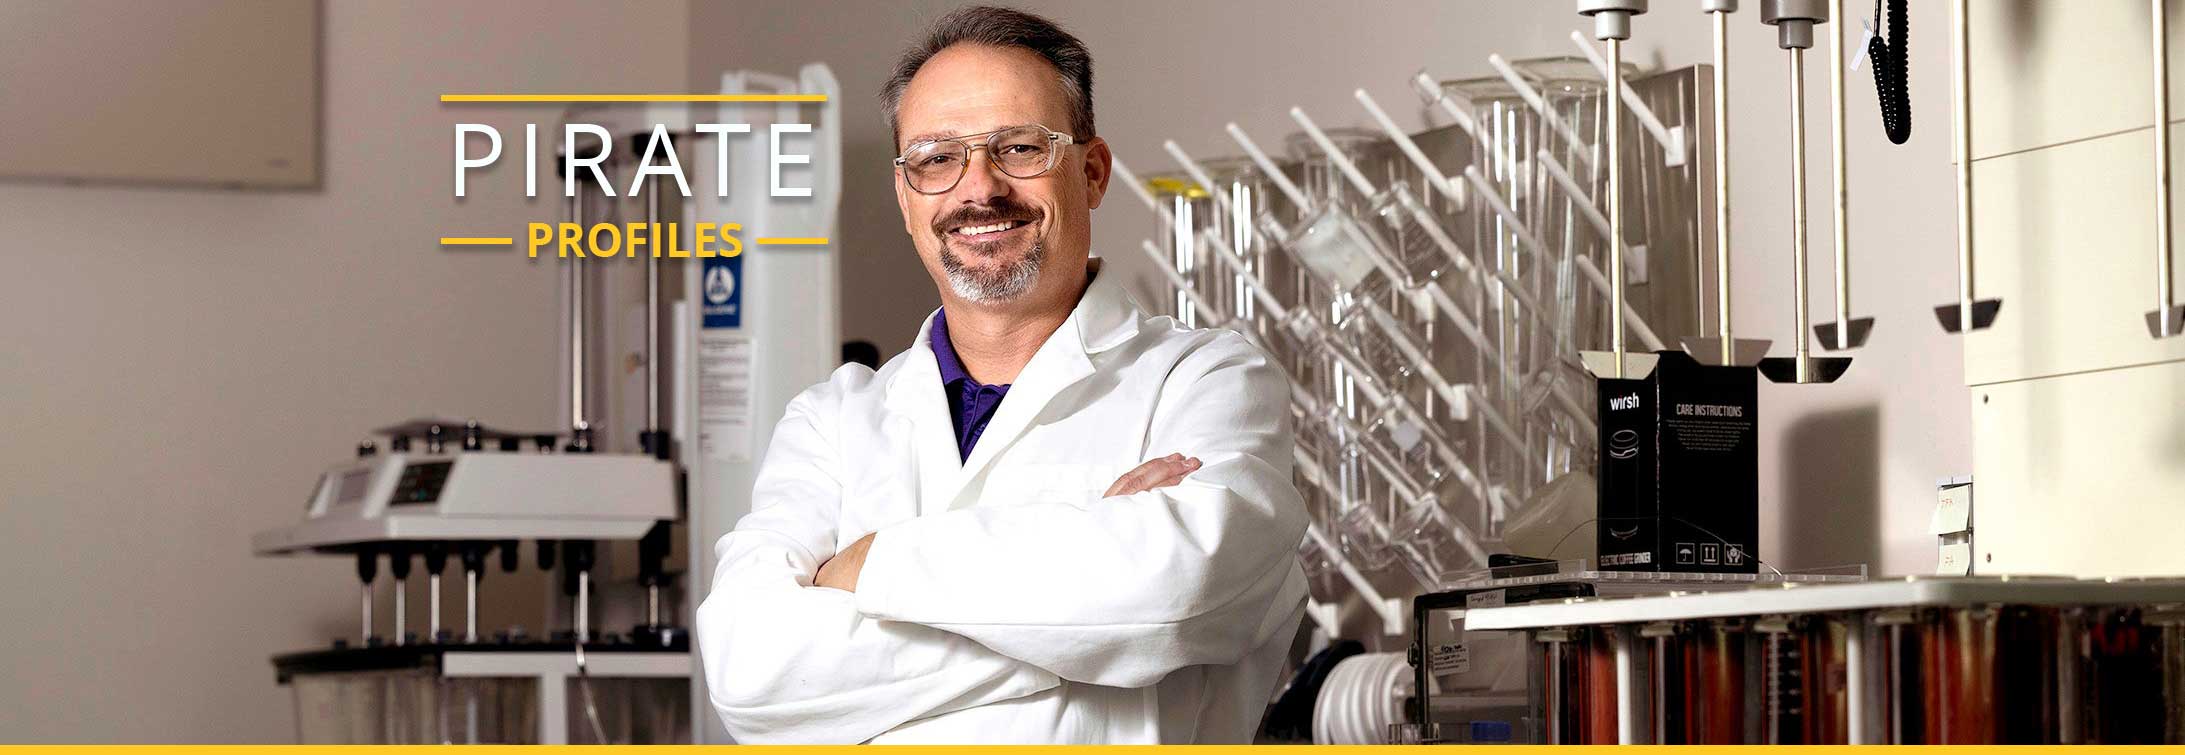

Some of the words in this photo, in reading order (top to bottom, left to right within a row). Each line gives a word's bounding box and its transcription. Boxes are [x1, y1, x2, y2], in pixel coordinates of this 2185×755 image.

[1610, 392, 1640, 411] wirsh
[1676, 403, 1694, 416] CARE
[1695, 404, 1743, 417] INSTRUCTIONS
